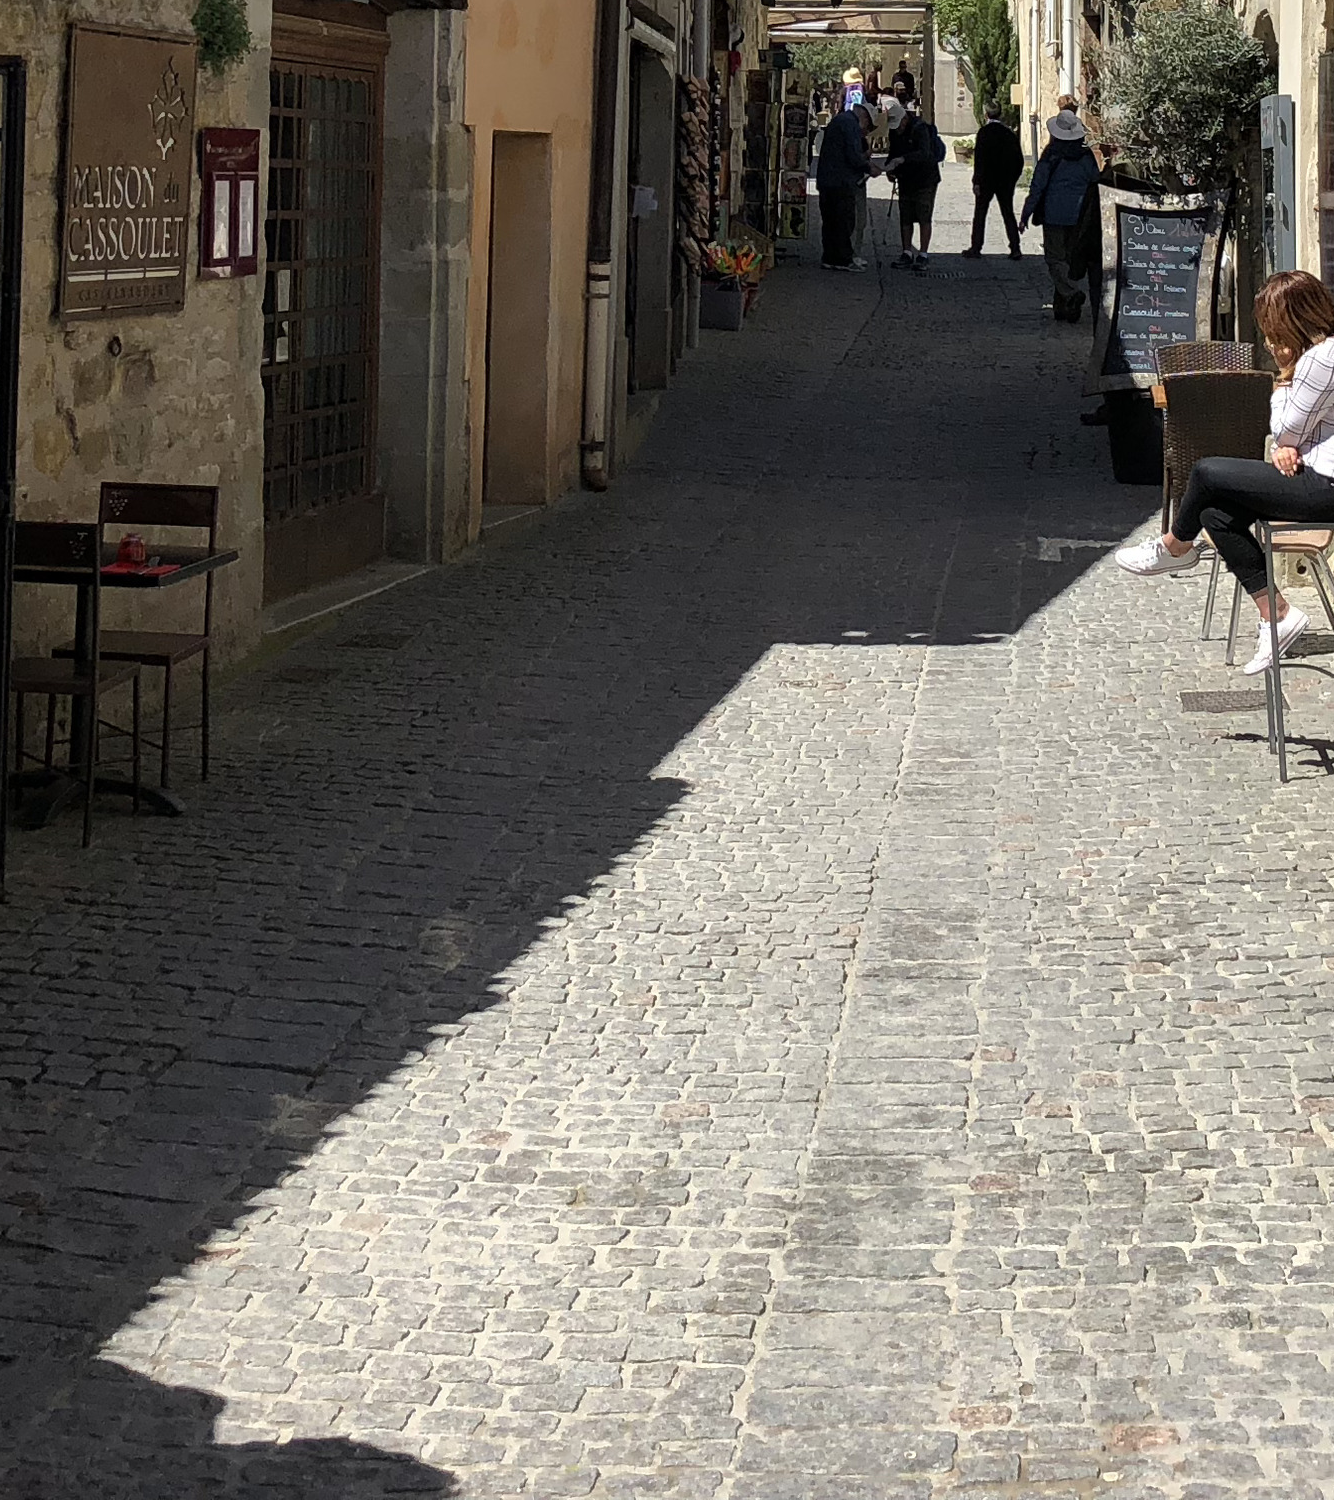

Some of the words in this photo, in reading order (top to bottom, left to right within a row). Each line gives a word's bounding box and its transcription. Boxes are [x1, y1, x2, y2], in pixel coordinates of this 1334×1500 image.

[71, 165, 157, 209] MAISON
[163, 171, 180, 203] du
[67, 216, 184, 262] CASSOULET
